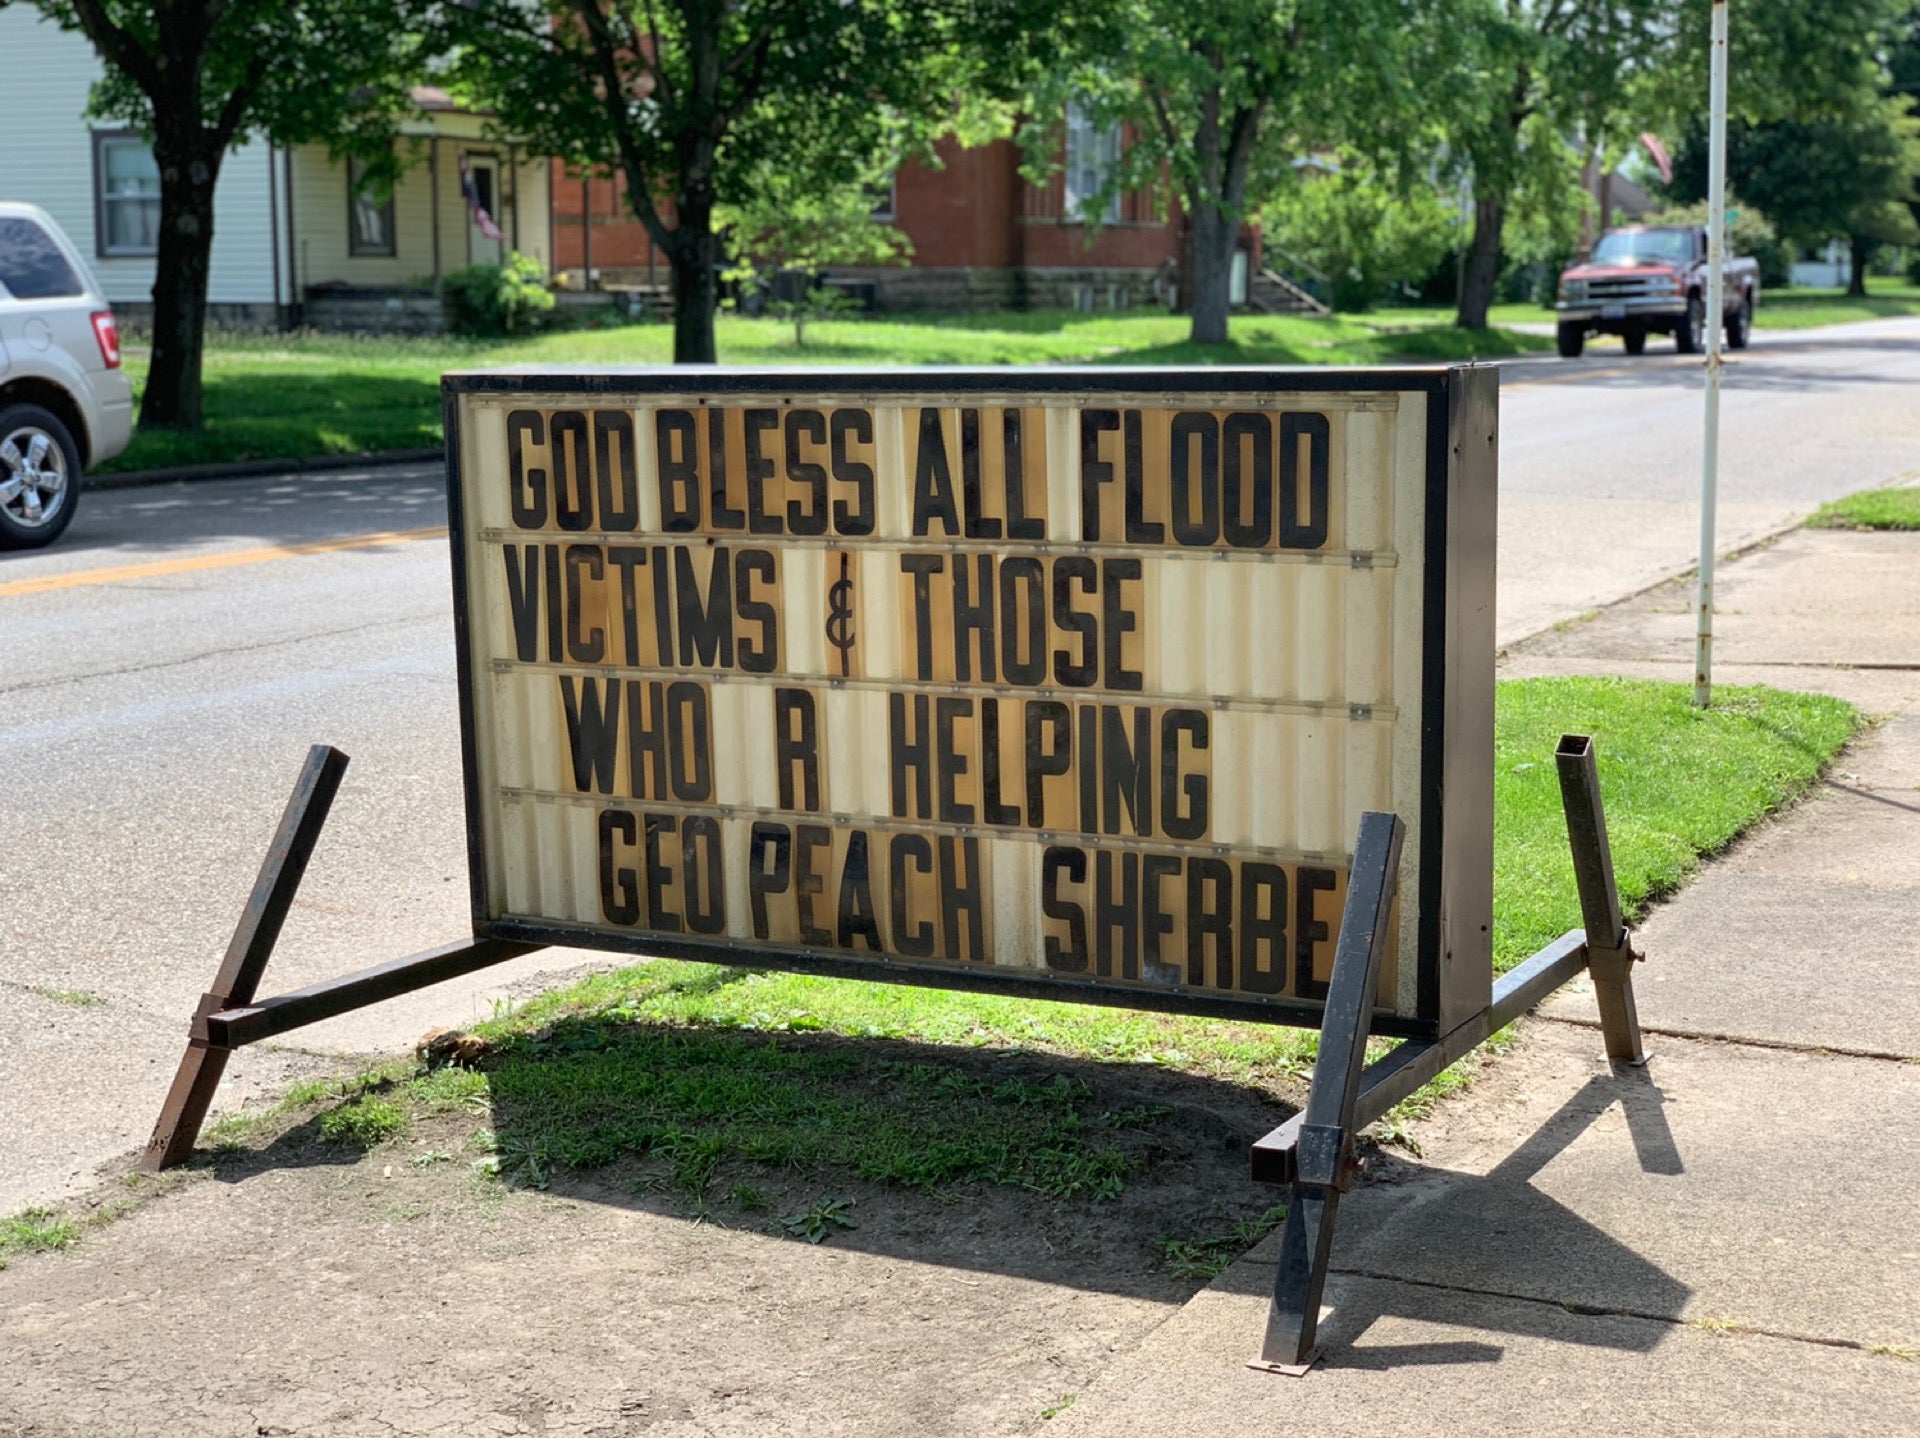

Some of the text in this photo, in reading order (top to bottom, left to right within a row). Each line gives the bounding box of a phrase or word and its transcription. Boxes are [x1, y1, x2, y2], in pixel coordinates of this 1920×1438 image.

[507, 407, 1330, 549] GOD BLESS ALL FLOOD
[503, 544, 1143, 691] VICTIMS & THOSE
[559, 675, 1208, 840] WHO R HELPING
[599, 809, 1356, 1001] GEO PEACH SHERBE
